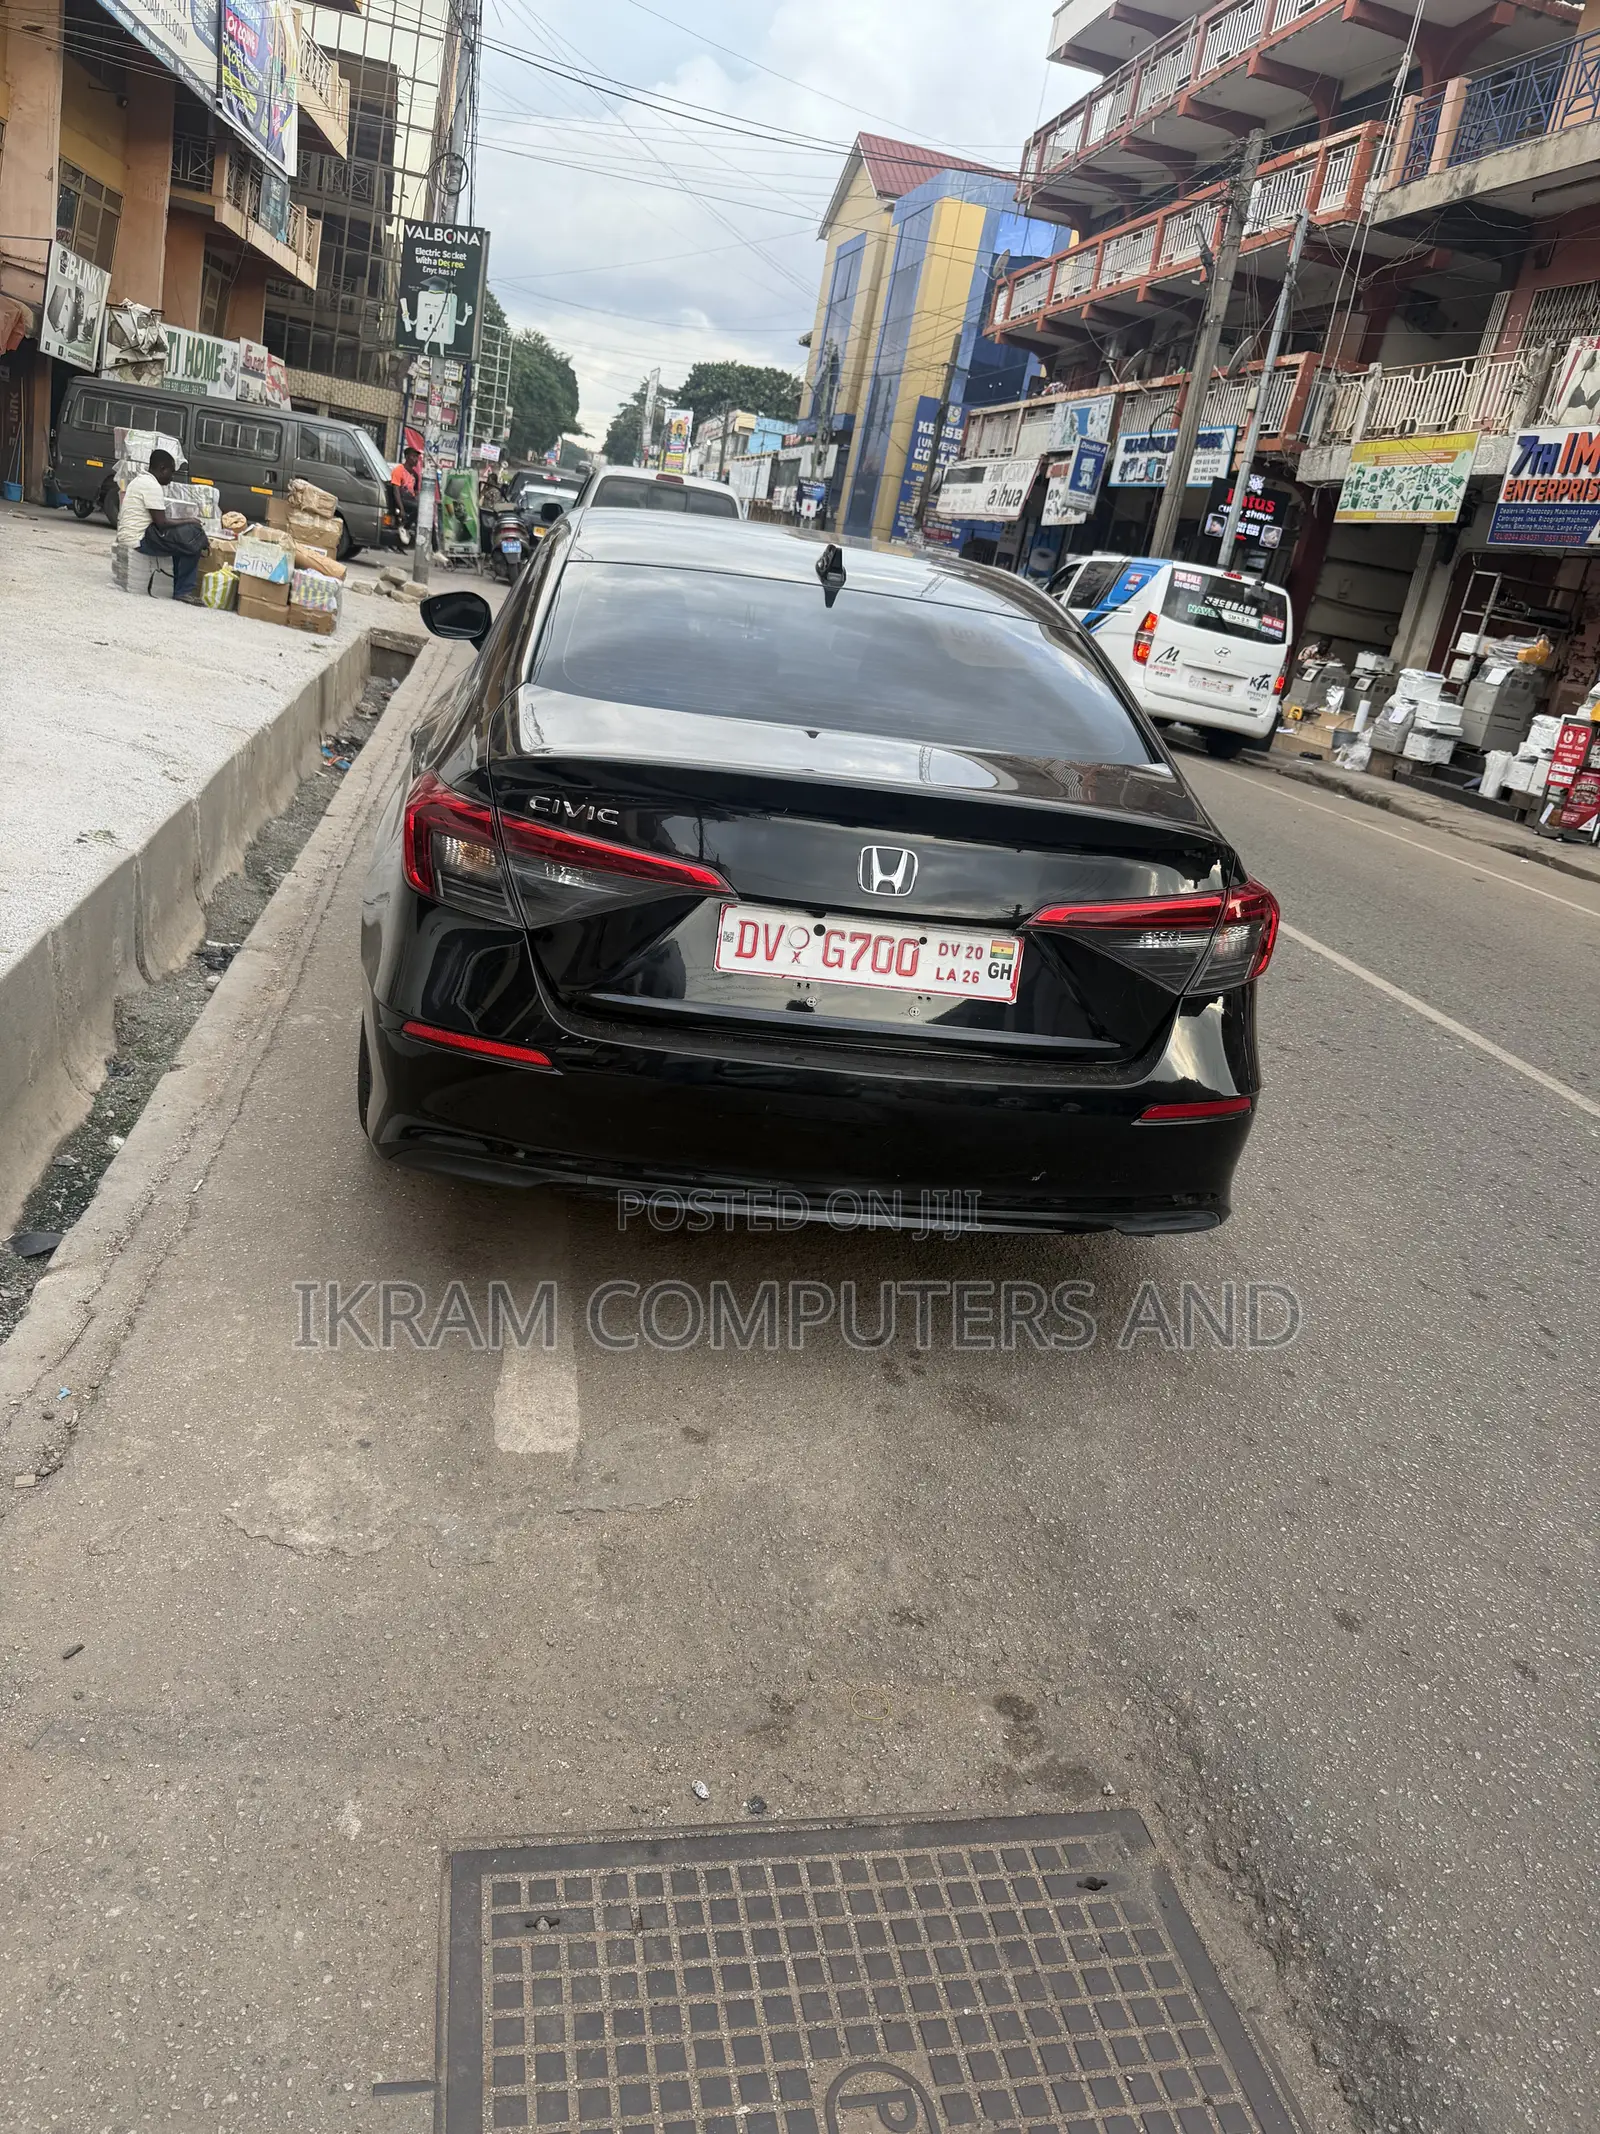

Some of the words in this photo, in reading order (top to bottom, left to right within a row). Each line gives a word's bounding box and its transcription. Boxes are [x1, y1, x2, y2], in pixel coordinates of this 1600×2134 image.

[405, 224, 480, 246] VALBONA
[415, 247, 441, 258] Electric
[183, 335, 223, 381] HOME
[1249, 673, 1272, 691] KTA
[528, 794, 620, 826] CIVIC
[734, 920, 785, 962] DV
[821, 929, 920, 978] G700
[938, 942, 960, 958] DV
[966, 945, 984, 961] 20
[936, 966, 957, 983] LA
[963, 970, 981, 985] 26
[987, 961, 1013, 982] GH
